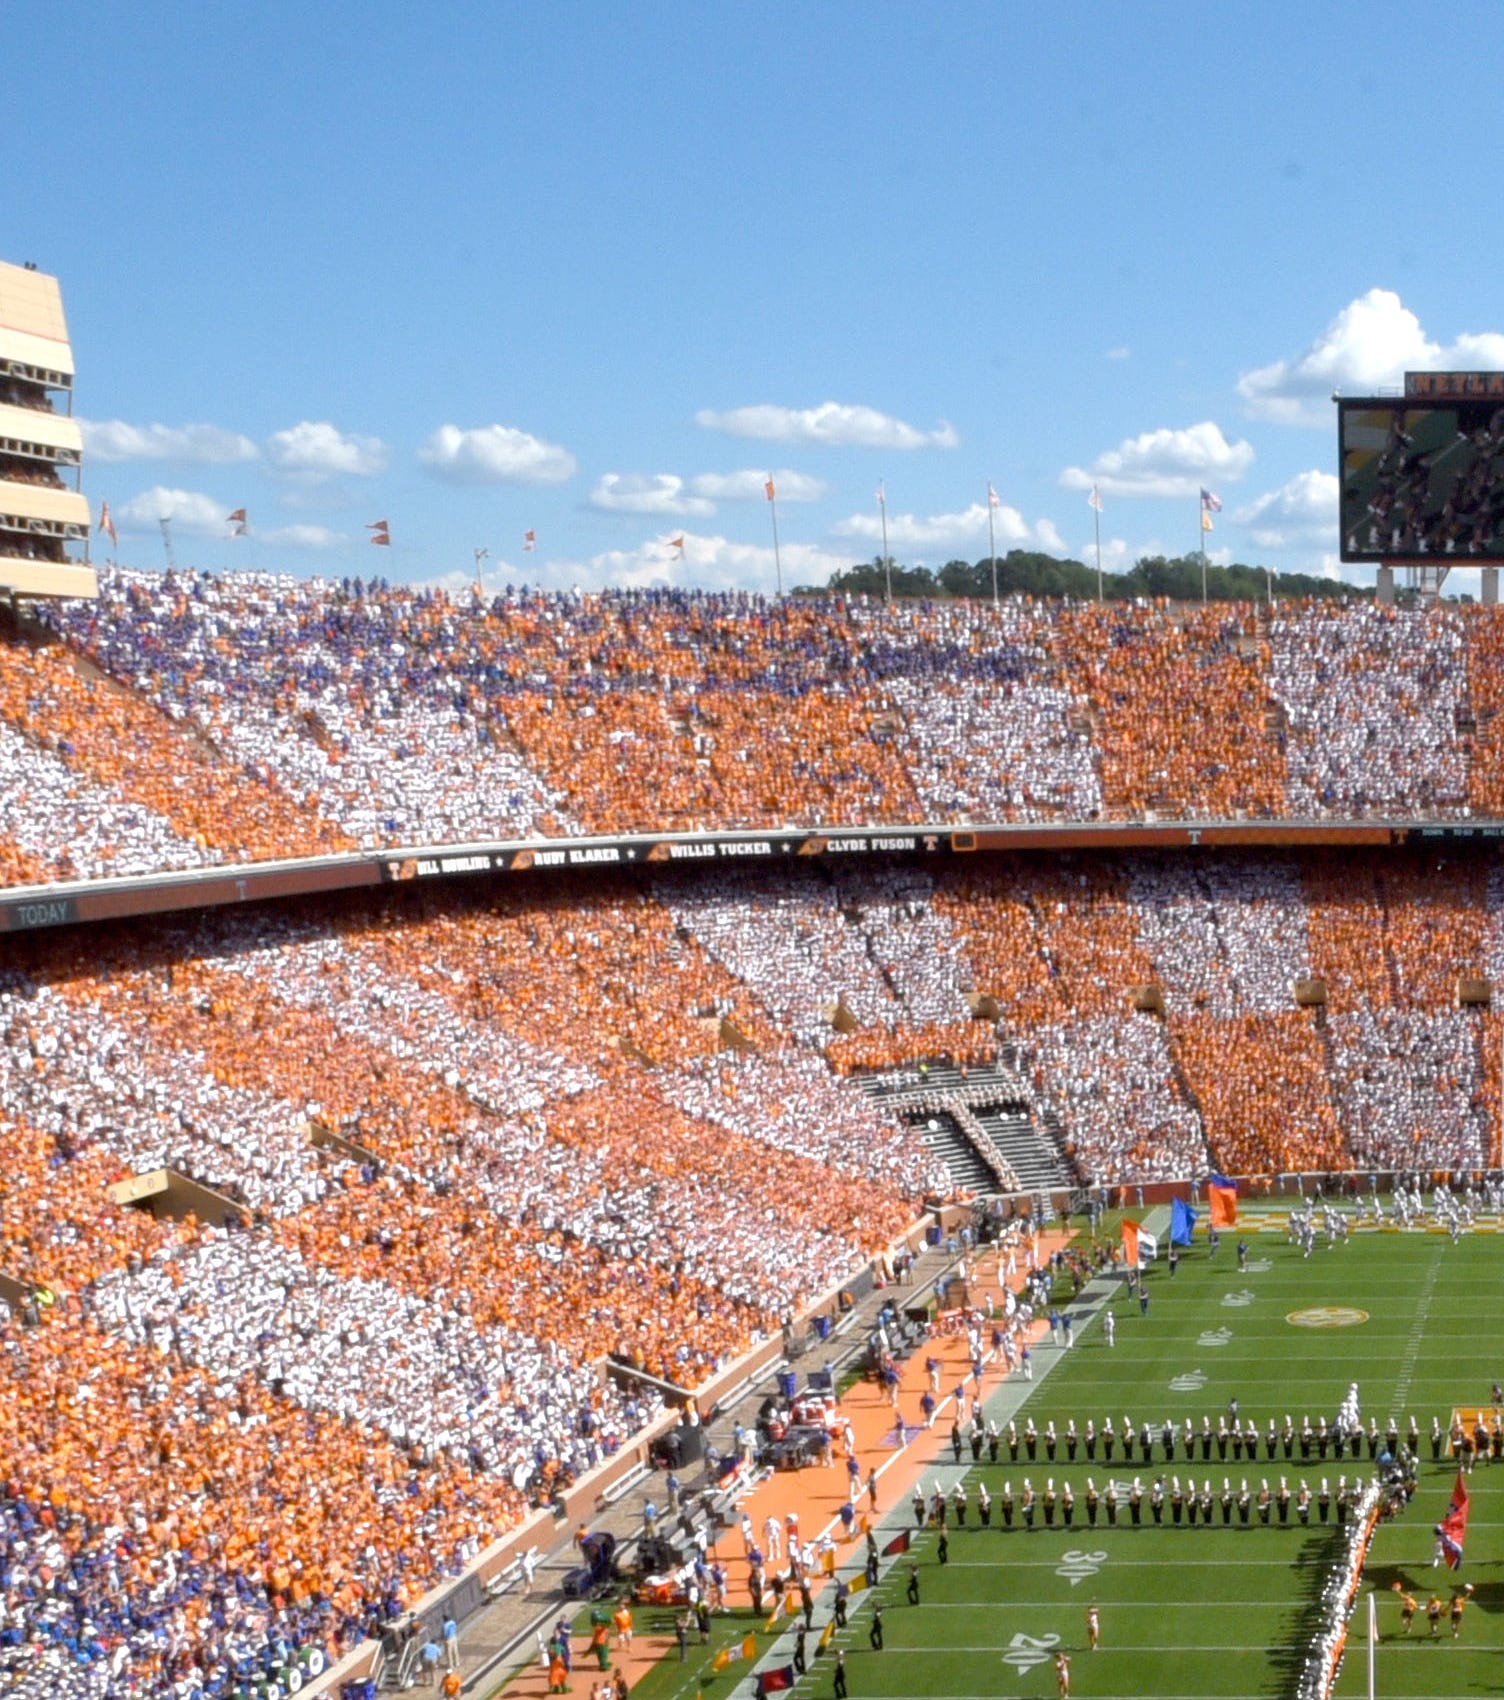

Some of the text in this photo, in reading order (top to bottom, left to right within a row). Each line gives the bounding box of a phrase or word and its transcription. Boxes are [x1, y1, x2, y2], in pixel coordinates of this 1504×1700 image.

[669, 844, 715, 858] WILLIS
[719, 842, 771, 856] TUCKER
[827, 839, 867, 852] CLYDE
[871, 837, 915, 851] FUSON
[534, 851, 566, 866] RUDY
[569, 848, 620, 863] KLARER
[17, 903, 68, 926] TODAY
[1055, 1550, 1108, 1578] 30
[1001, 1632, 1062, 1666] 20
